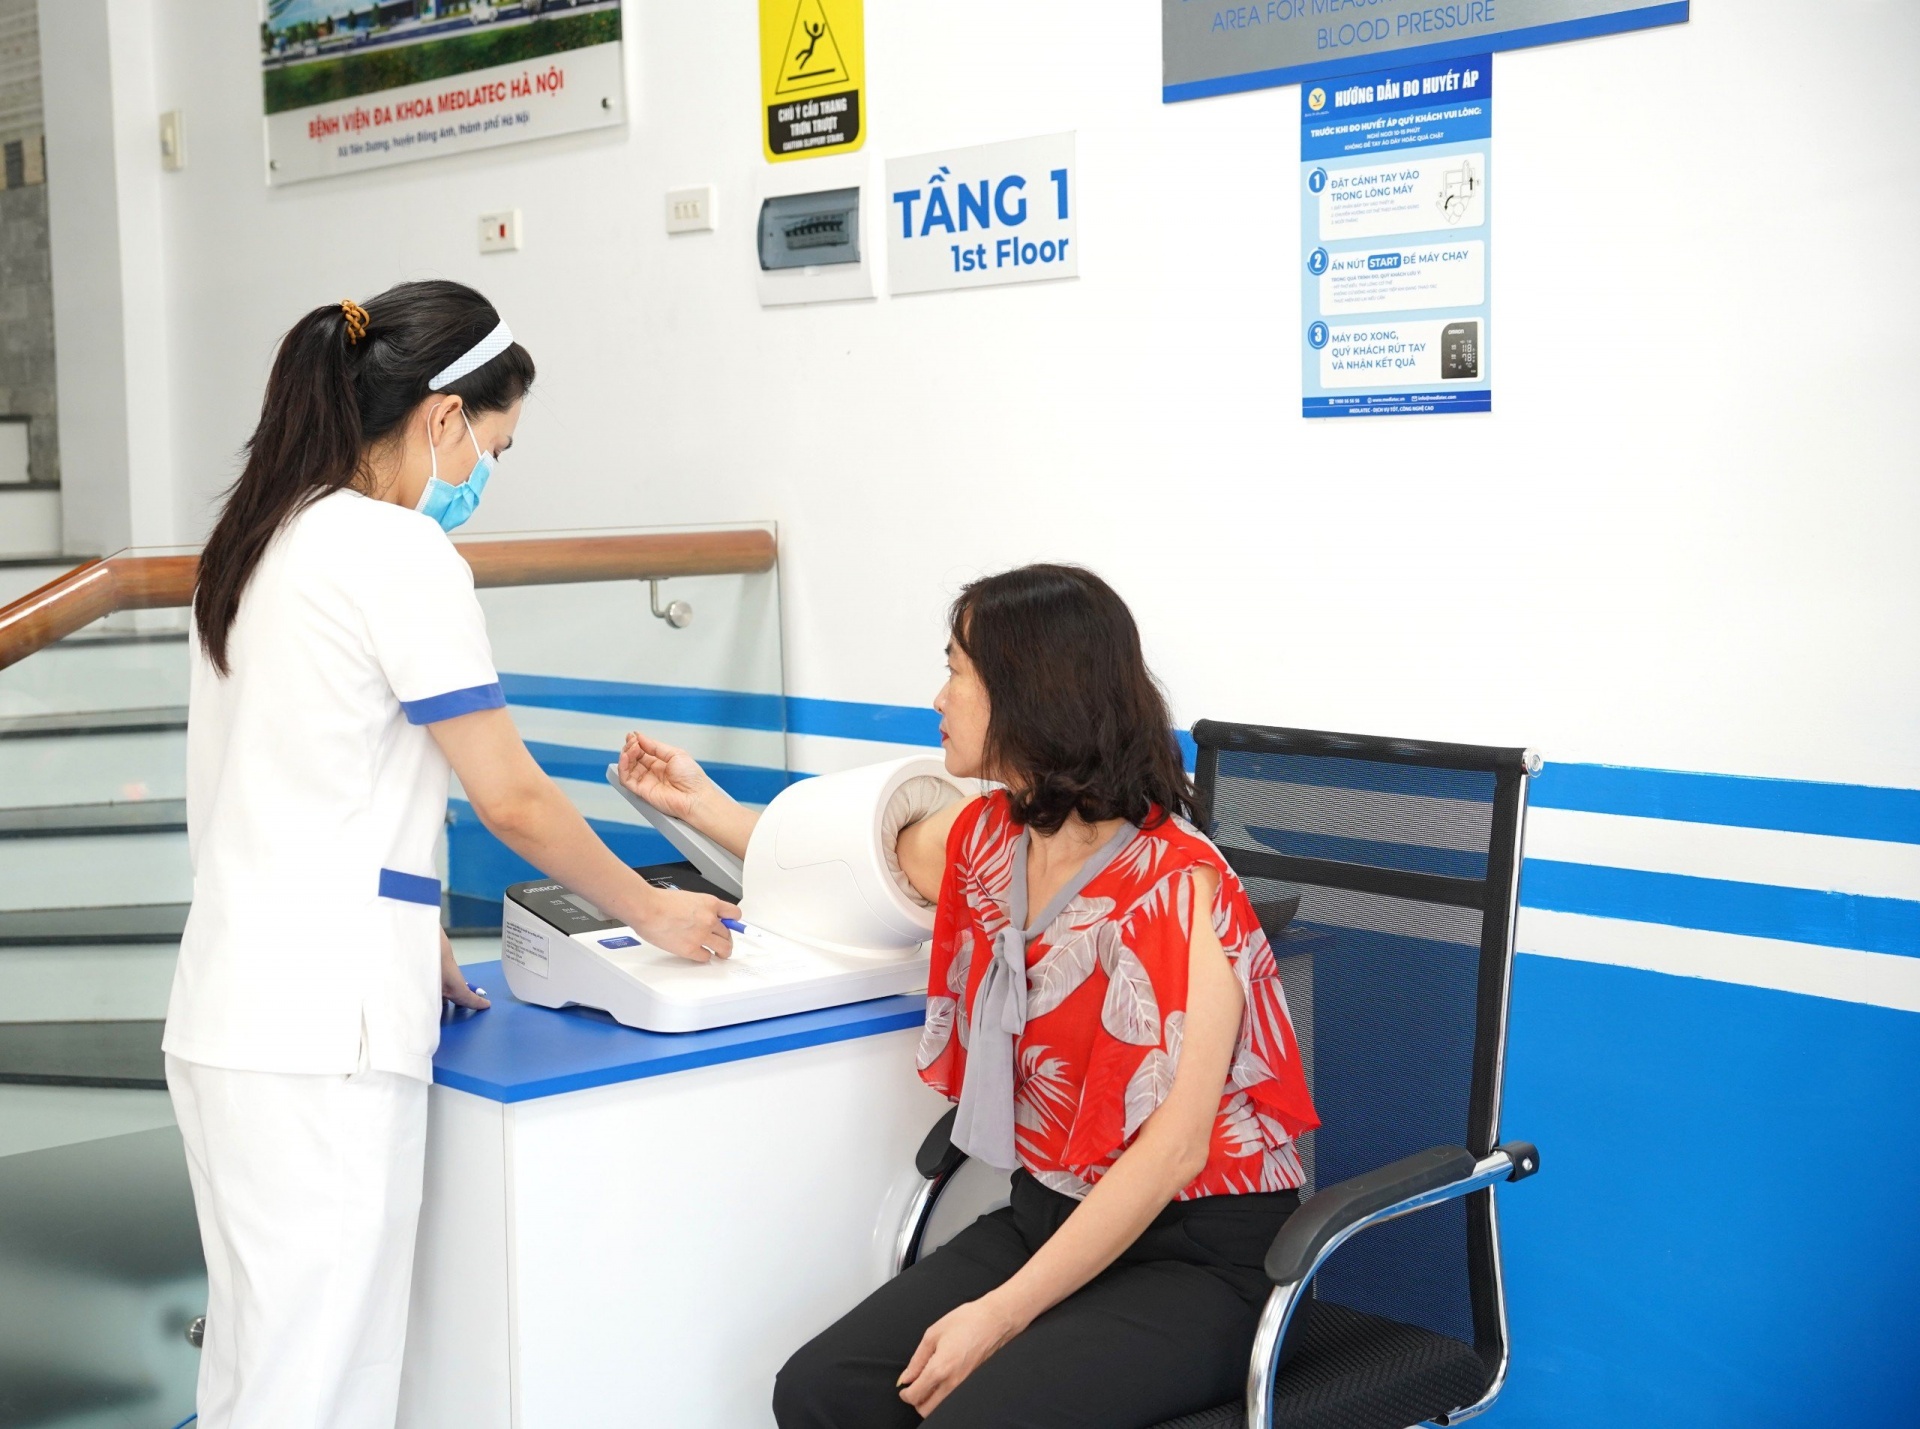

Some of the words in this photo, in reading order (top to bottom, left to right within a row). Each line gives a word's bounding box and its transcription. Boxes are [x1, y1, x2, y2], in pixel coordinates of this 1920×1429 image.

[1211, 11, 1261, 33] AREA
[1267, 0, 1304, 24] FOR
[1317, 18, 1390, 50] BLOOD
[1396, 0, 1495, 36] PRESSURE
[1335, 85, 1374, 108] HƯỚNG
[1376, 78, 1400, 102] DẪN
[1403, 79, 1420, 98] ĐO
[1422, 69, 1460, 94] HUYẾT
[1462, 68, 1479, 89] ÁP
[309, 114, 339, 142] BỆNH
[342, 106, 370, 135] VIỆN
[373, 107, 391, 126] ĐA
[396, 99, 434, 122] KHOA
[438, 82, 506, 113] MEDLATEC
[511, 71, 531, 99] HÀ
[536, 66, 564, 97] NỘI
[820, 97, 847, 115] THANG
[1310, 127, 1335, 138] TRƯỚC
[1335, 125, 1349, 134] KHI
[1349, 124, 1361, 133] ĐO
[1361, 118, 1386, 131] HUYẾT
[1386, 117, 1397, 128] ÁP
[1398, 115, 1414, 126] QUÝ
[1414, 112, 1443, 124] KHÁCH
[1444, 110, 1457, 120] VUI
[1458, 107, 1482, 117] LÒNG:
[1313, 173, 1320, 189] 1
[1331, 178, 1349, 191] ĐẶT
[1351, 174, 1379, 186] CÁNH
[1380, 173, 1396, 184] TAY
[1399, 170, 1420, 181] VÀO
[893, 166, 1027, 239] TẦNG
[1050, 168, 1068, 220] 1
[1331, 191, 1363, 202] TRONG
[1365, 187, 1391, 199] LÒNG
[1393, 184, 1414, 196] MÁY
[951, 244, 987, 272] 1st
[996, 236, 1069, 268] Floor
[1314, 253, 1322, 269] 2
[1346, 258, 1365, 269] NÚT
[1369, 256, 1399, 268] START
[1403, 253, 1416, 265] ĐỂ
[1419, 251, 1440, 263] MÁY
[1441, 250, 1469, 263] CHẠY
[1314, 327, 1322, 343] 3
[1332, 332, 1351, 343] MÁY
[1353, 332, 1367, 341] ĐO
[1370, 331, 1399, 341] XONG,
[1332, 346, 1350, 357] QUÝ
[1353, 344, 1385, 355] KHÁCH
[1388, 342, 1405, 353] RÚT
[1407, 343, 1426, 353] TAY
[1332, 358, 1344, 370] VÀ
[1346, 358, 1374, 371] NHẬN
[1375, 356, 1394, 368] KẾT
[1395, 355, 1416, 367] QUẢ
